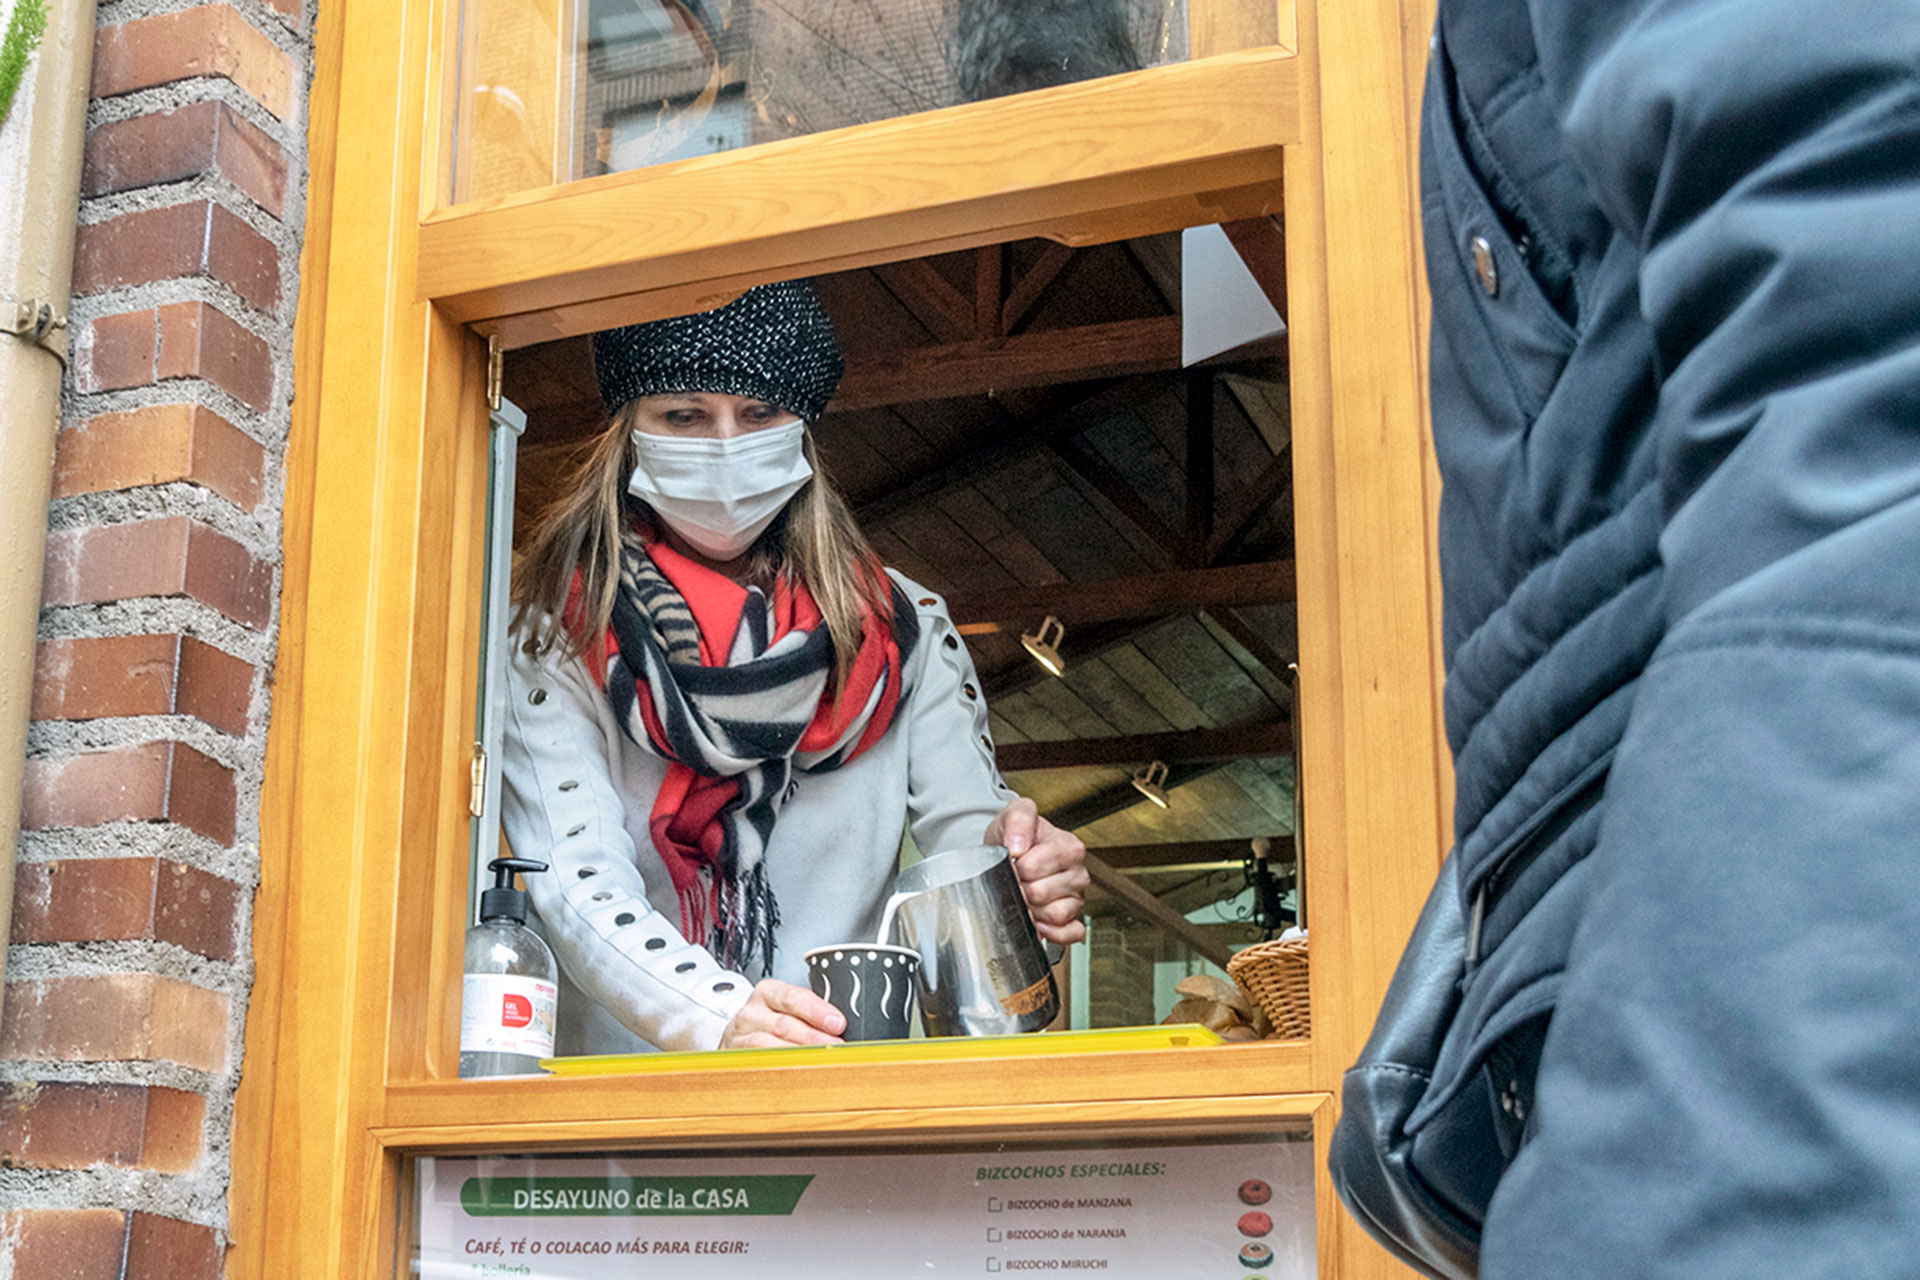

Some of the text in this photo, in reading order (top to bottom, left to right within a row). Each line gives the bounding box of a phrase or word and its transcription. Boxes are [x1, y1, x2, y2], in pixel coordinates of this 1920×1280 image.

[976, 1162, 1167, 1180] BIZCOCHOS ESPECIALES:
[513, 1188, 750, 1209] DESAYUNO de la CASA
[1007, 1198, 1133, 1210] BIZCOCHO de MANZANA
[1006, 1228, 1127, 1240] BIZCOCHO de NARANJA
[465, 1236, 750, 1257] CAFÉ, TÉ O COLACAO MÁS PARA ELEGIR:
[1006, 1258, 1109, 1270] BIZCOCHO MIRUCHI
